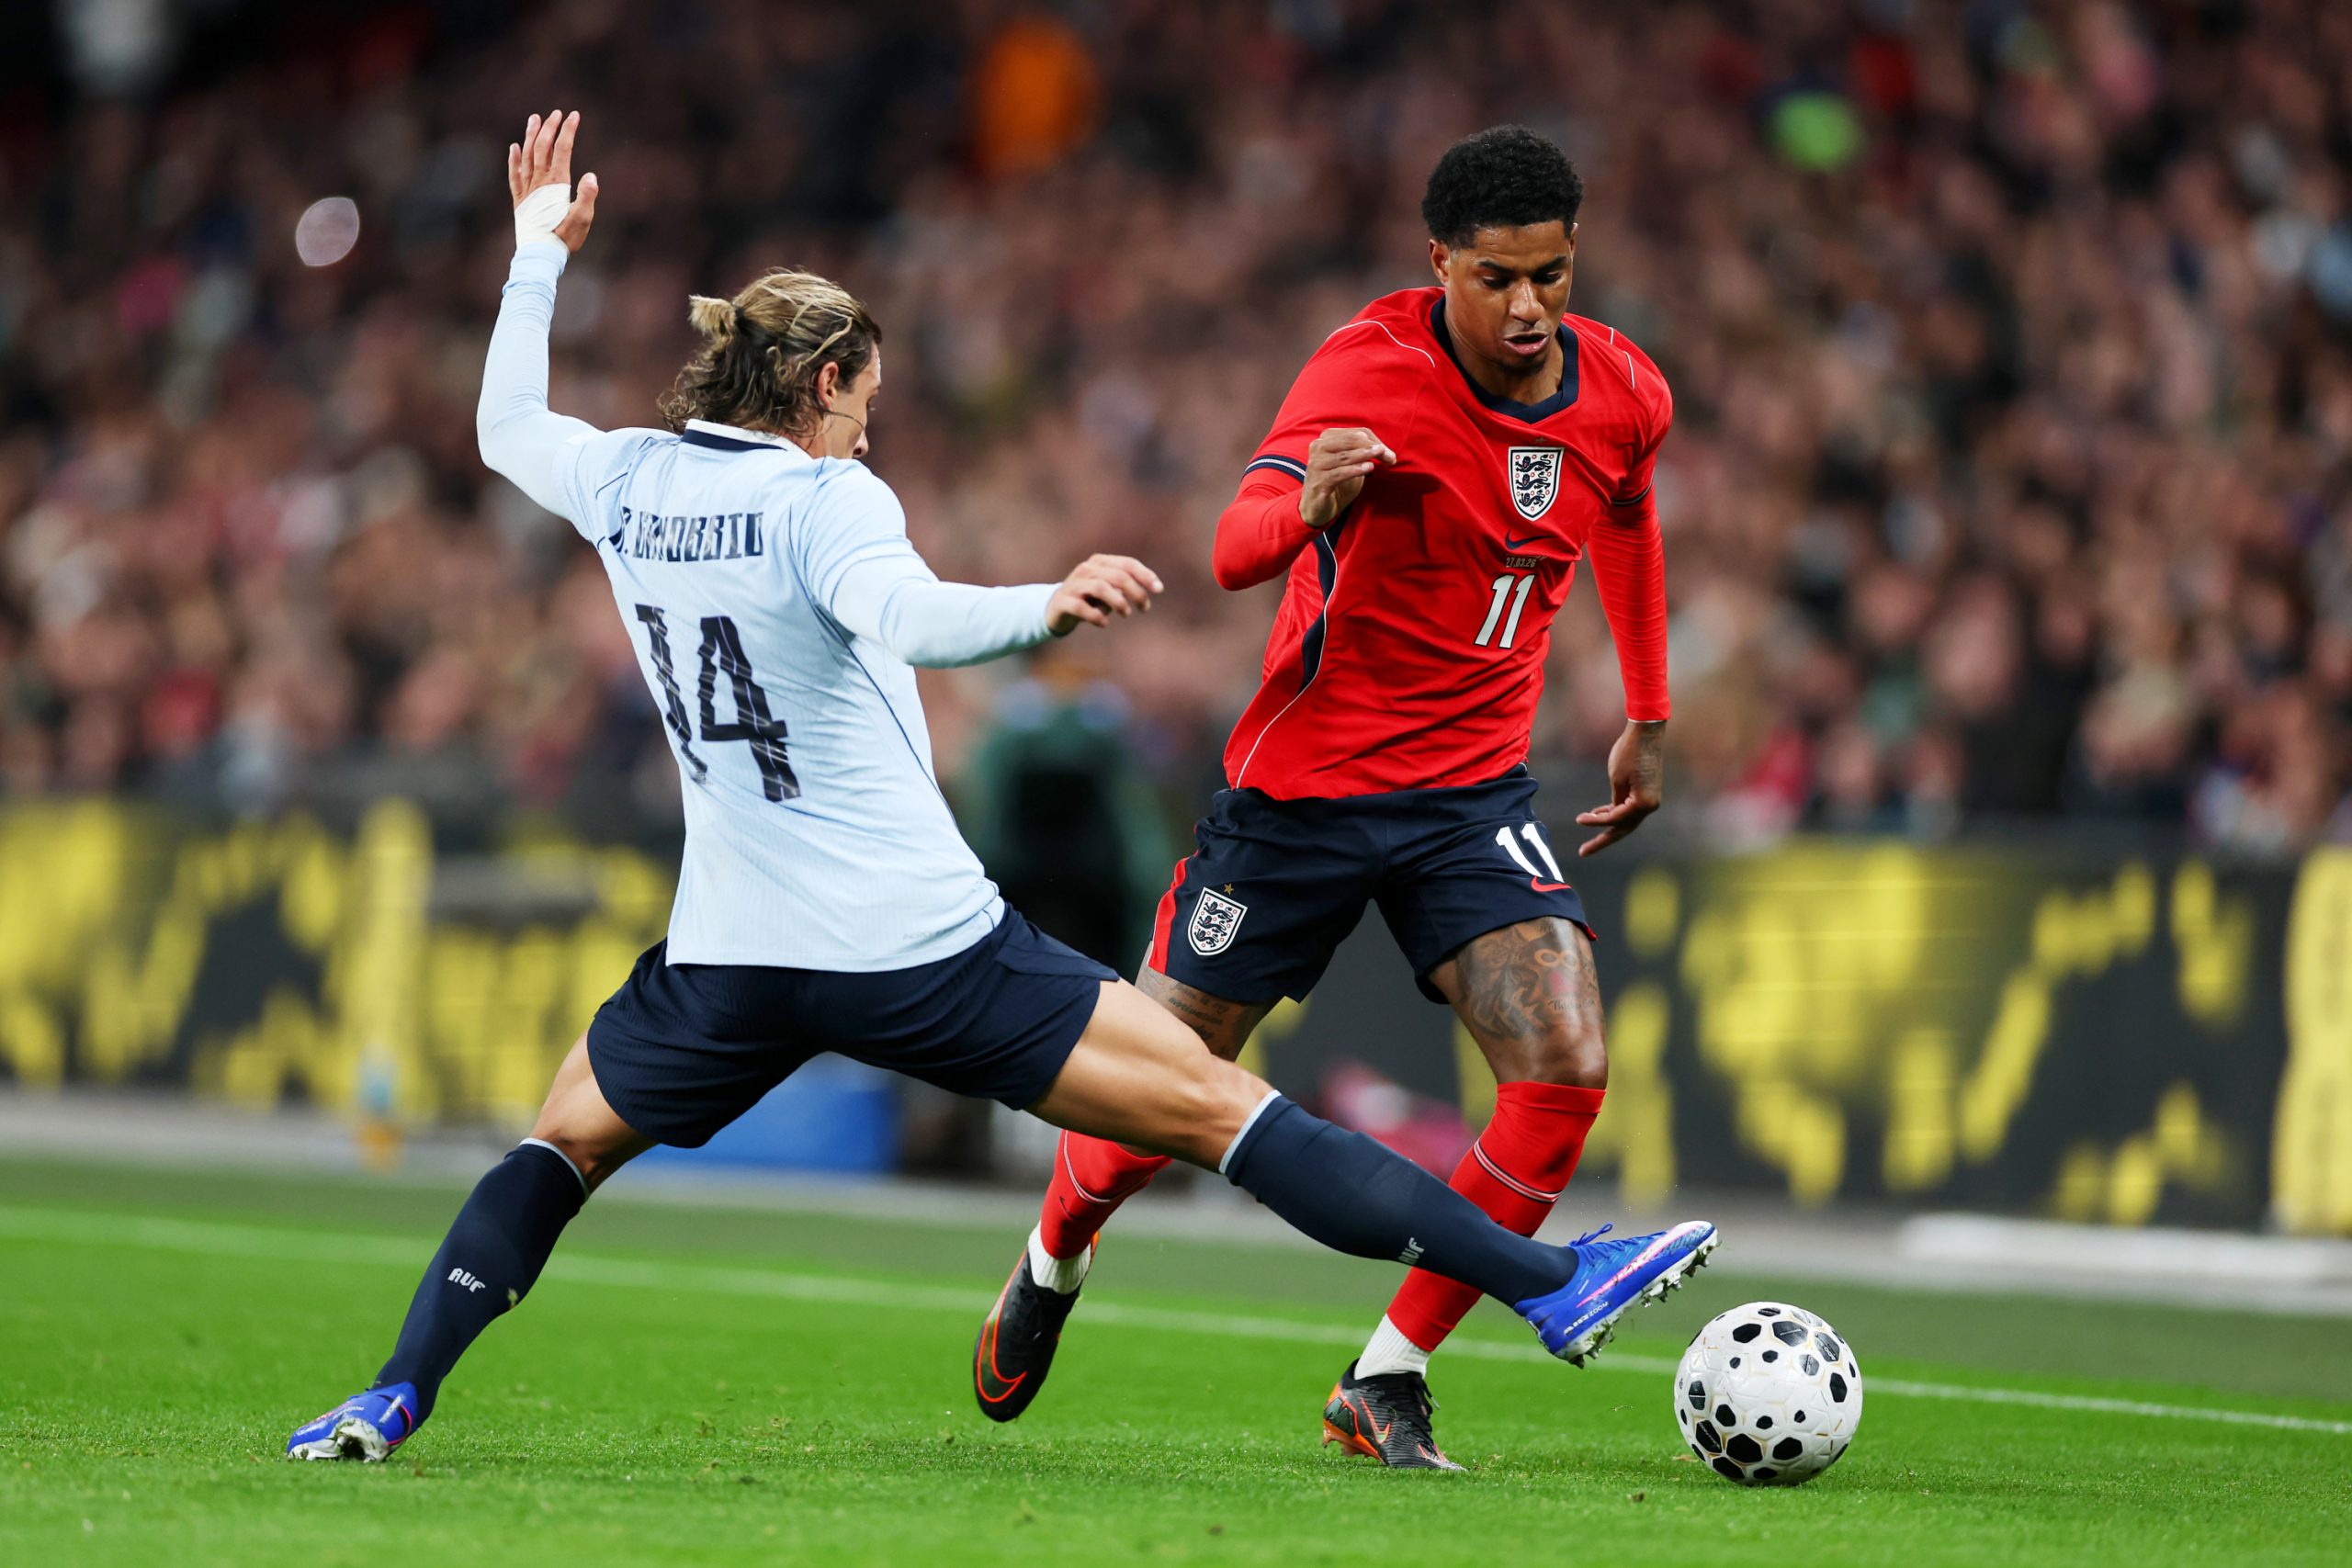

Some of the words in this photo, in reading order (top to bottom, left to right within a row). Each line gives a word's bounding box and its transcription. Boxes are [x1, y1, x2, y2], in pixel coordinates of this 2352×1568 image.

[1474, 573, 1536, 649] 11
[634, 603, 802, 804] 14
[1495, 823, 1565, 883] 11
[447, 1268, 486, 1293] AUF
